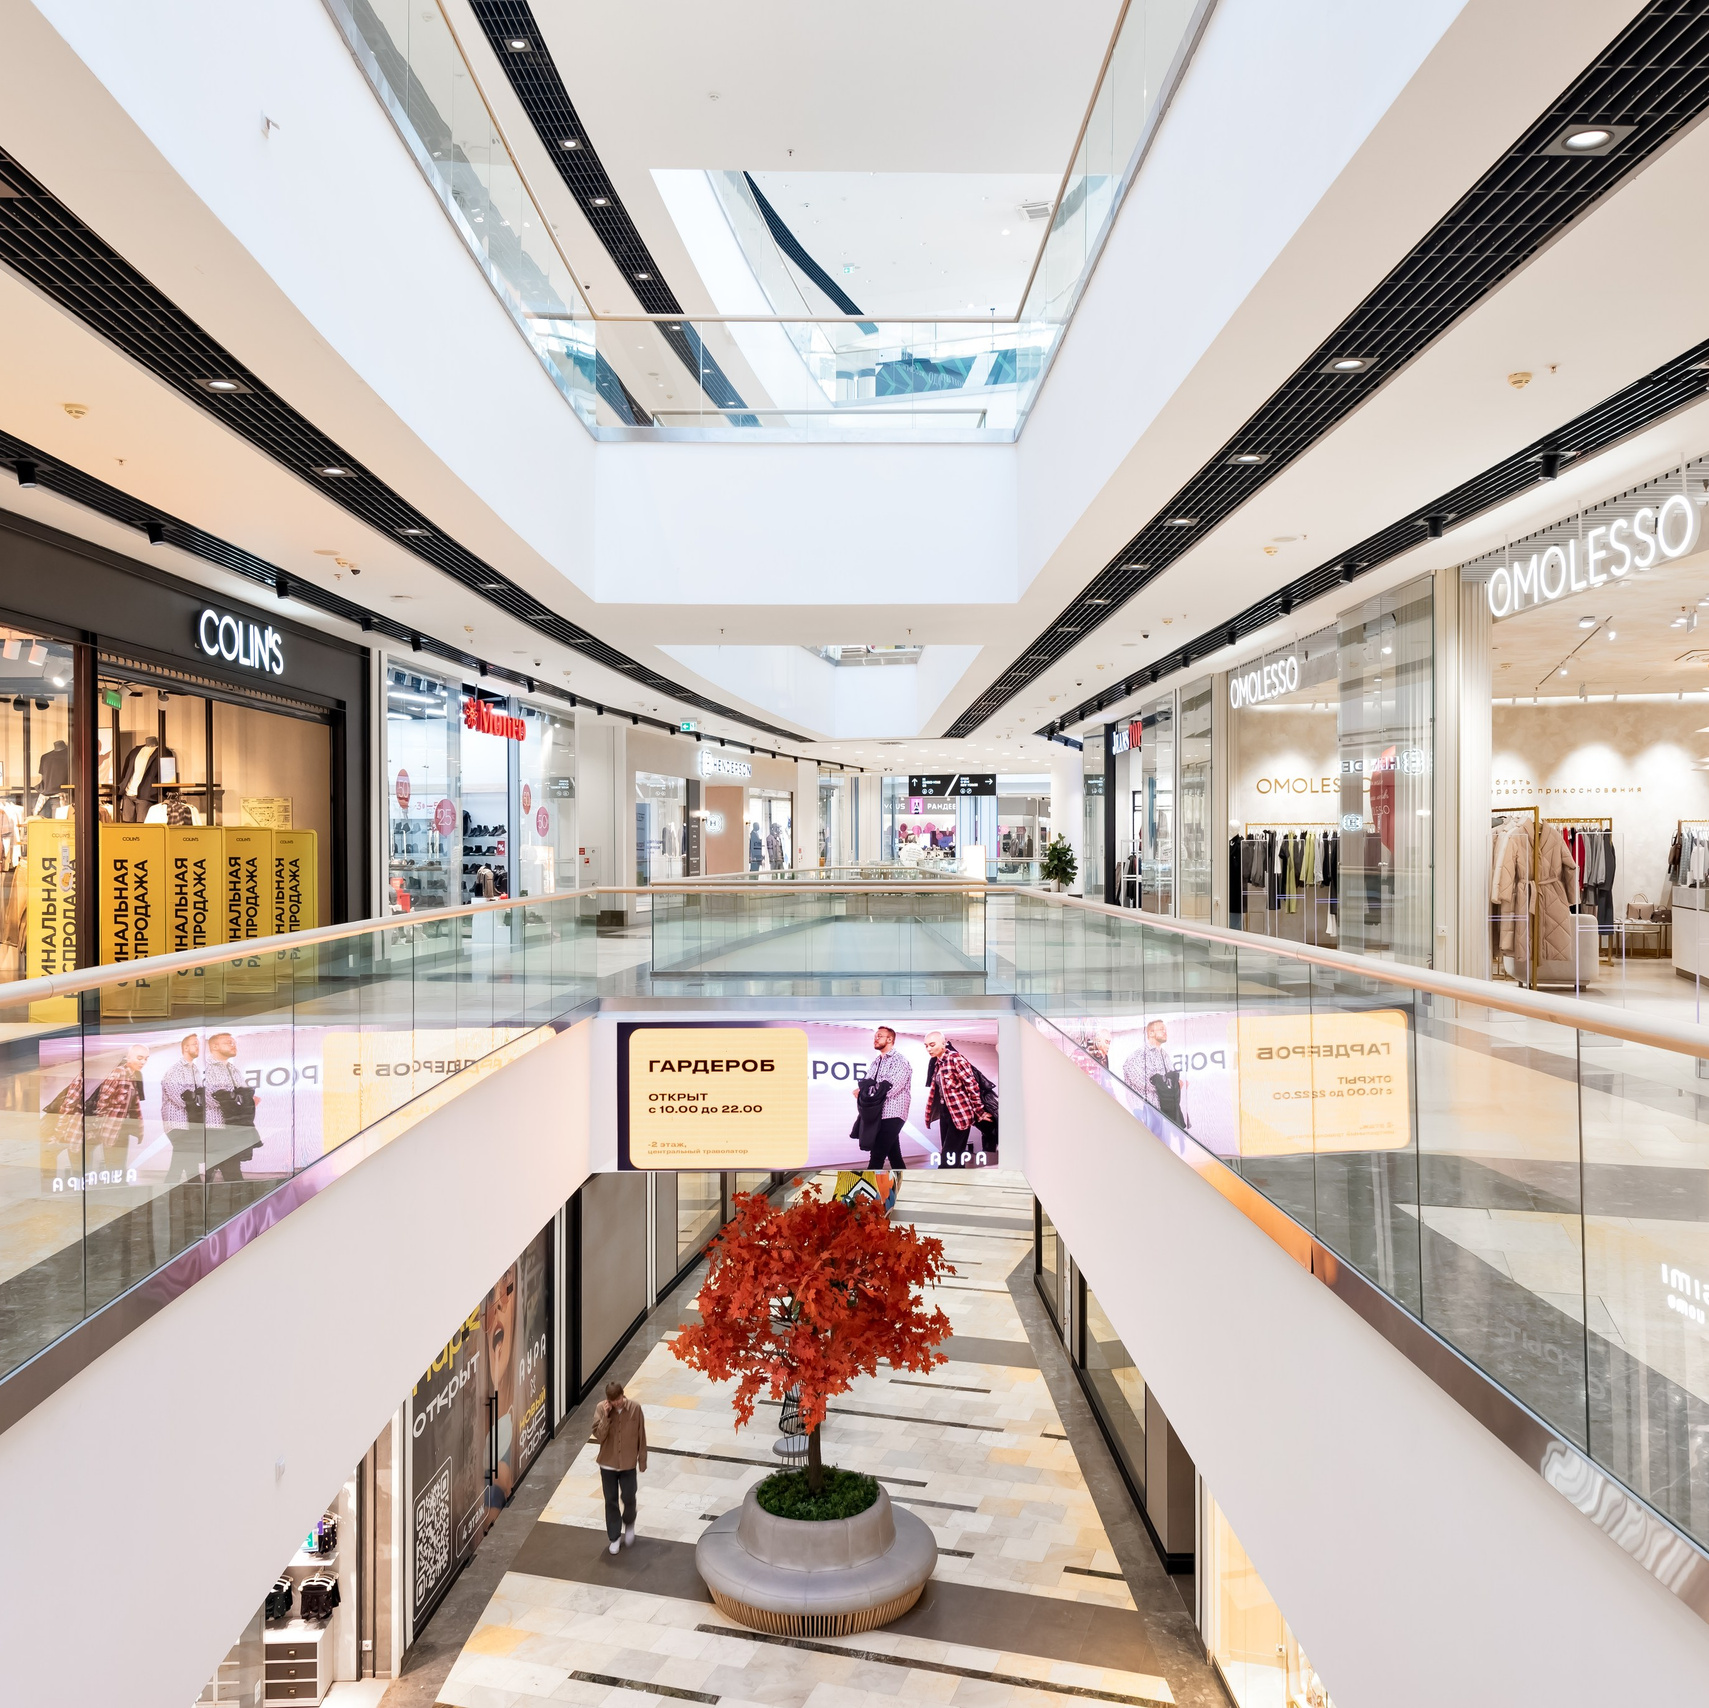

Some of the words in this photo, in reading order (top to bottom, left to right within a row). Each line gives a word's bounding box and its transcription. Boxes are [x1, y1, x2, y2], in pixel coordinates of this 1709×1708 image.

[1489, 495, 1694, 617] OMOLESSO
[200, 609, 284, 675] COLIN'S
[1230, 656, 1298, 709] OMOLESSO
[713, 758, 751, 777] HENDERSON
[1537, 787, 1642, 795] прикосновения
[648, 1059, 775, 1074] ГАРДЕРОБ
[648, 1093, 709, 1102] ОТКРЫТ
[648, 1106, 657, 1114] с
[659, 1105, 698, 1114] 10.00
[701, 1106, 718, 1114] до
[721, 1104, 763, 1114] 22.00
[930, 1151, 988, 1166] АУРА
[519, 1333, 547, 1386] АУРА
